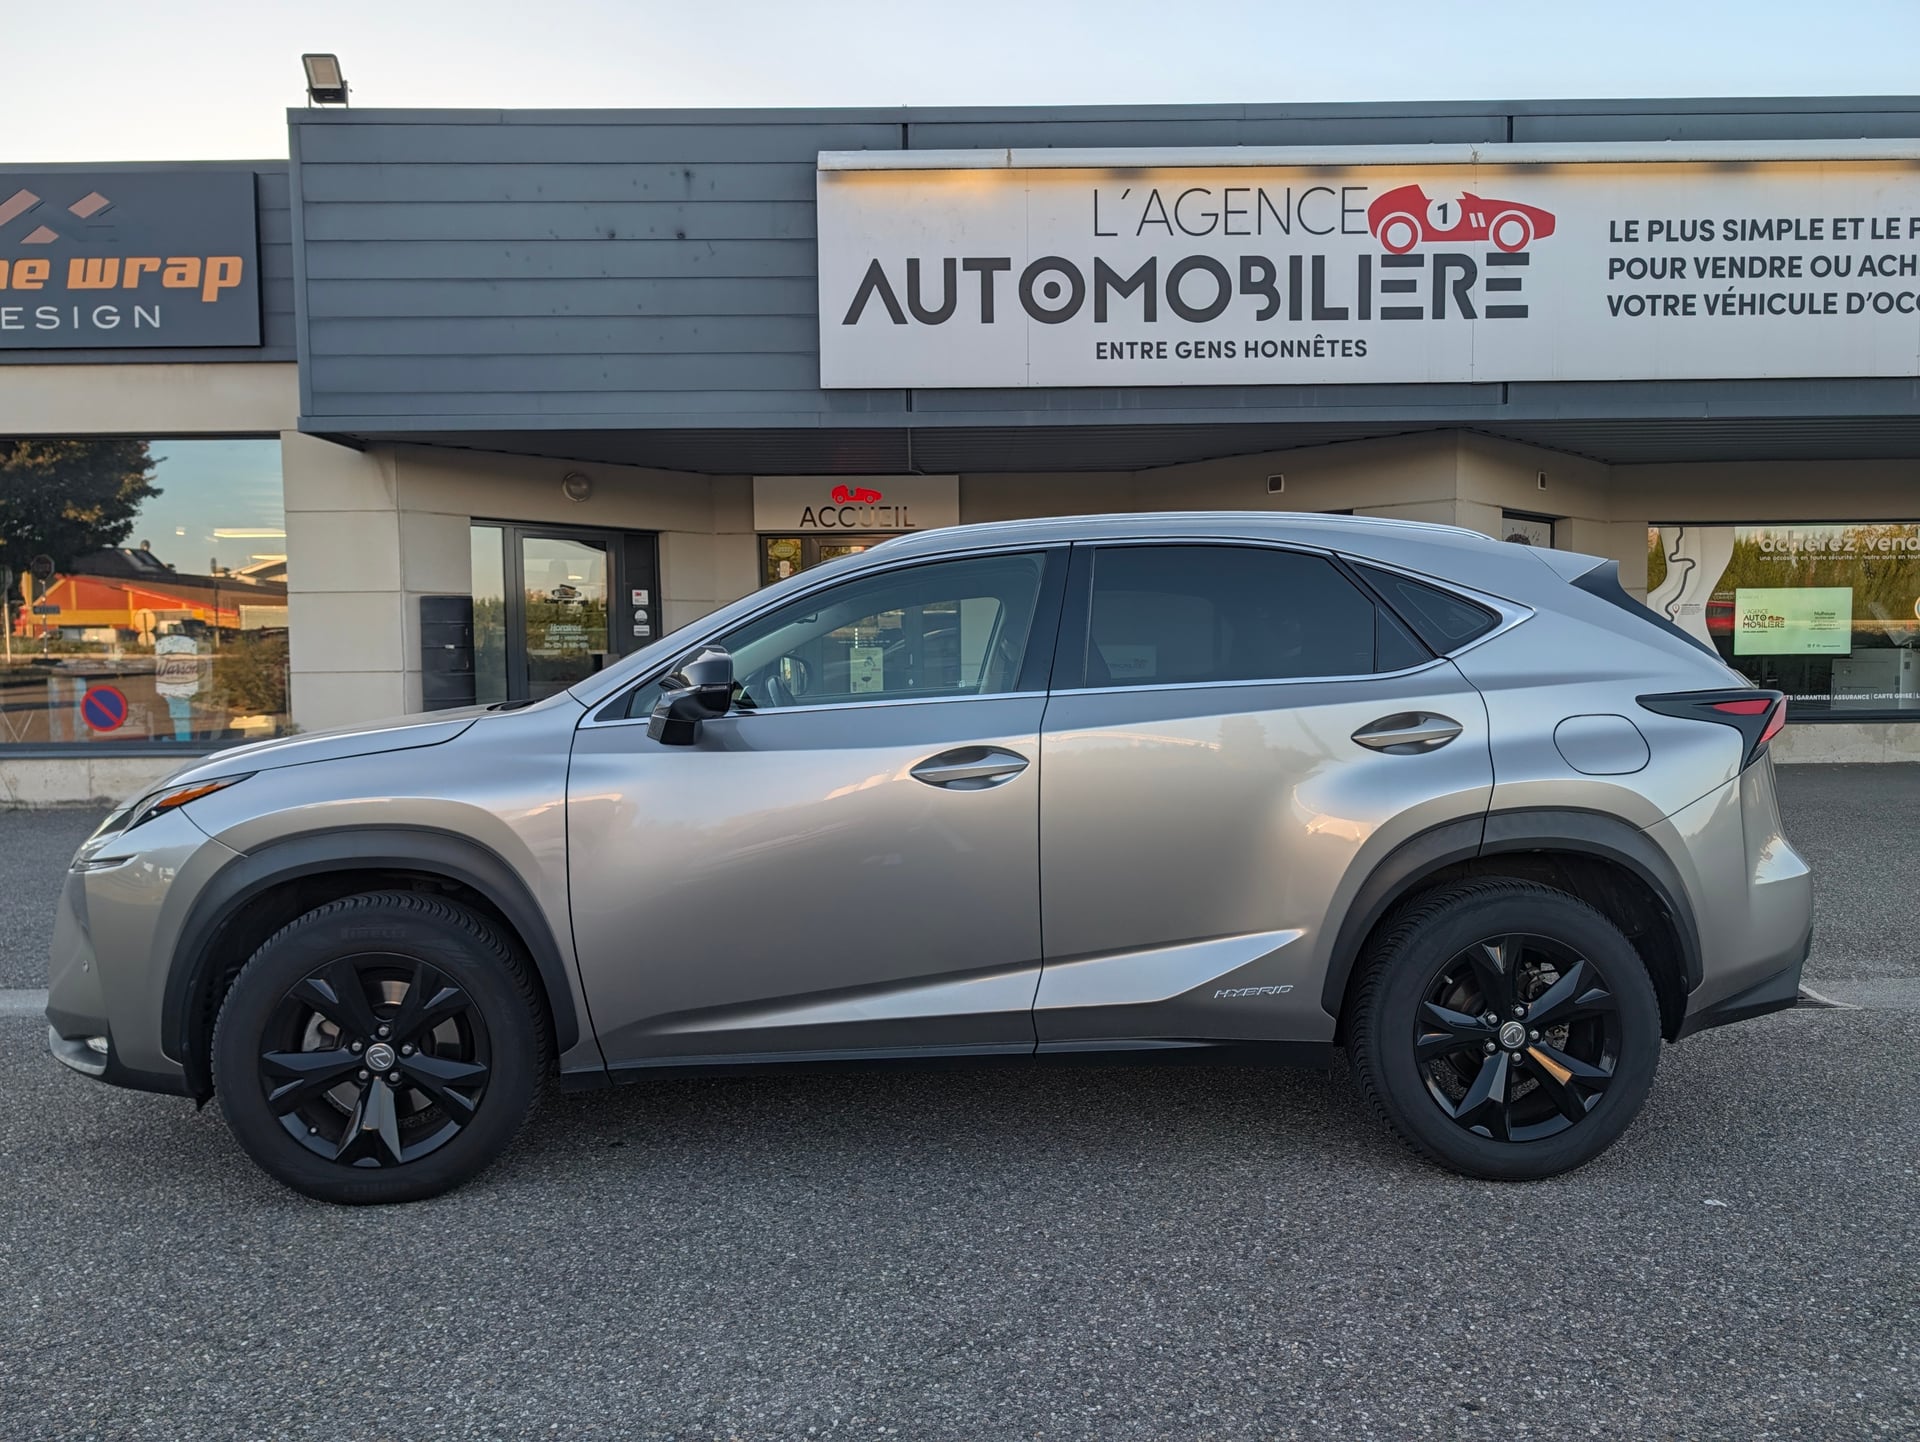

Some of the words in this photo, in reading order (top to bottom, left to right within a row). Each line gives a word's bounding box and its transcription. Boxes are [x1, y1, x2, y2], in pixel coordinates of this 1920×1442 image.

[1609, 220, 1640, 243] LE
[1647, 219, 1716, 243] PLUS
[1722, 217, 1825, 242] SIMPLE
[1832, 217, 1865, 241] ET
[1870, 217, 1901, 240] LE
[66, 255, 244, 303] wrap
[1608, 257, 1687, 280] POUR
[1693, 255, 1803, 279] VENDRE
[1809, 254, 1852, 279] OU
[1857, 253, 1918, 278] ACH
[1606, 294, 1697, 318] VOTRE
[1703, 285, 1839, 317] VÉHICULE
[1845, 291, 1920, 316] D'OC
[0, 303, 161, 331] ESIGN
[1096, 341, 1168, 361] ENTRE
[1174, 340, 1237, 360] GENS
[1244, 333, 1368, 360] HONNÊTES
[799, 506, 916, 528] ACCUEIL
[1760, 530, 1855, 553] achetez
[1213, 984, 1294, 999] HYBRID
